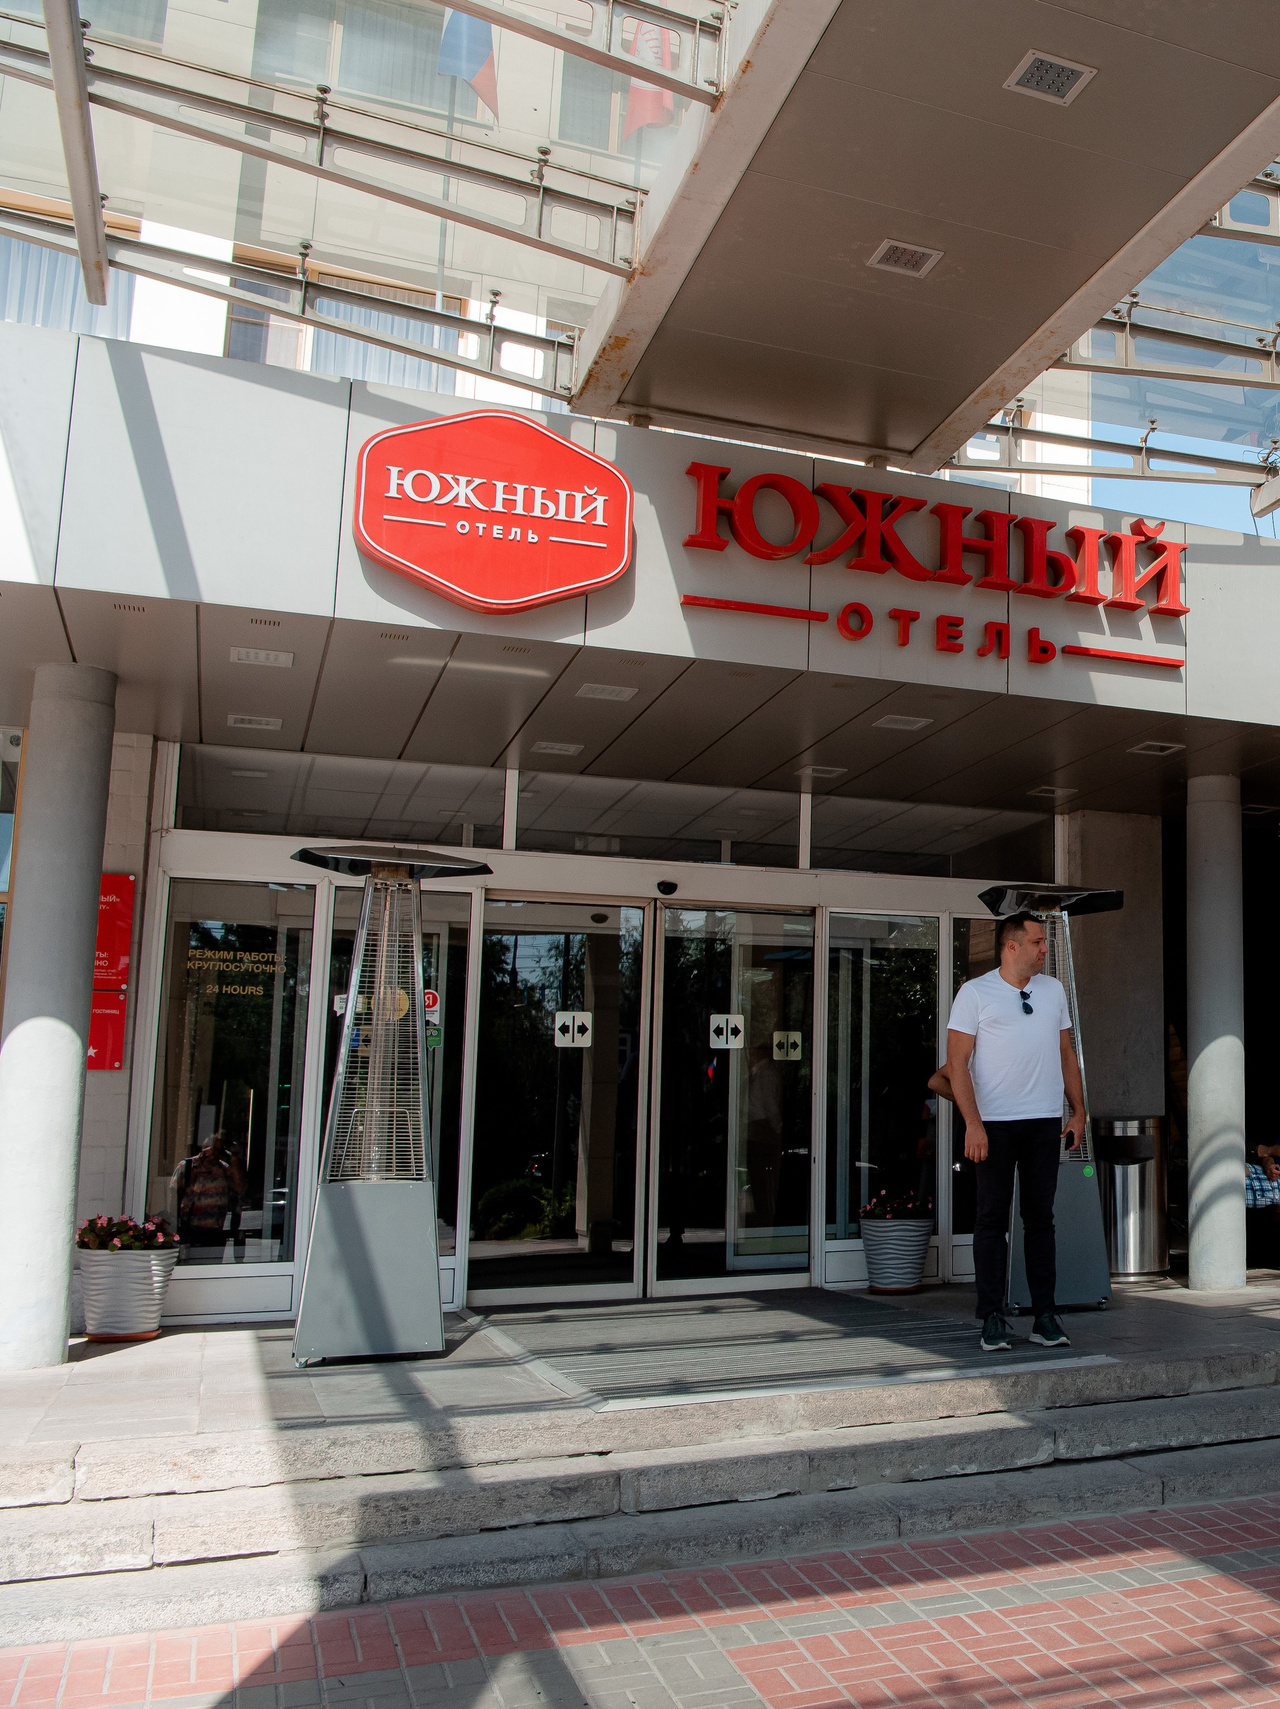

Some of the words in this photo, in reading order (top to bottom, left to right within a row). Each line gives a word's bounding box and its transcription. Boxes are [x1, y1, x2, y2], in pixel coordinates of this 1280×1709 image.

[384, 465, 609, 527] ЮЖНЫЙ
[456, 520, 539, 543] ОТЕЛЬ
[682, 461, 1190, 618] ЮЖНЫЙ
[836, 601, 1057, 663] ОТЕЛЬ
[187, 960, 287, 974] КРУГЛОСУТОЧНО
[188, 949, 234, 961] РЕЖИМ
[236, 951, 287, 963] РАБОТЫ:
[206, 984, 219, 994] 24
[222, 985, 264, 995] HOURS
